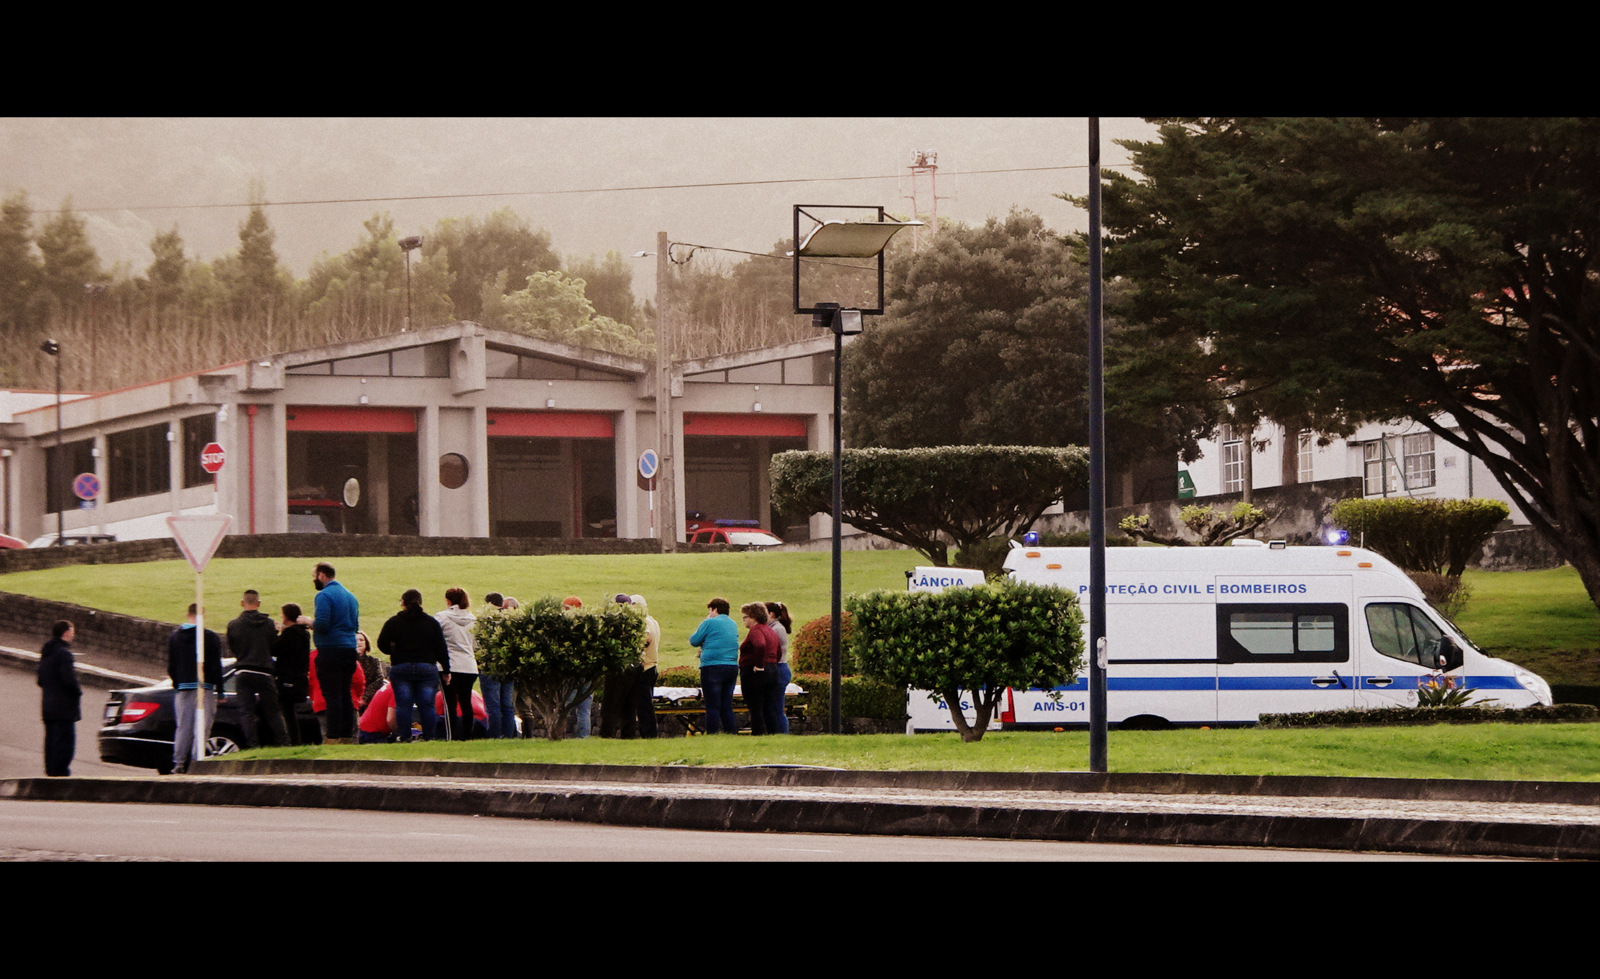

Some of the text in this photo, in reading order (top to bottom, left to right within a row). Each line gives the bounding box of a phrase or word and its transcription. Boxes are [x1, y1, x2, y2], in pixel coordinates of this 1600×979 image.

[201, 452, 225, 465] STOP
[1079, 582, 1307, 596] PTEÇÃO CIVIL E BOMBEIROS
[1033, 701, 1085, 711] AMS-01
